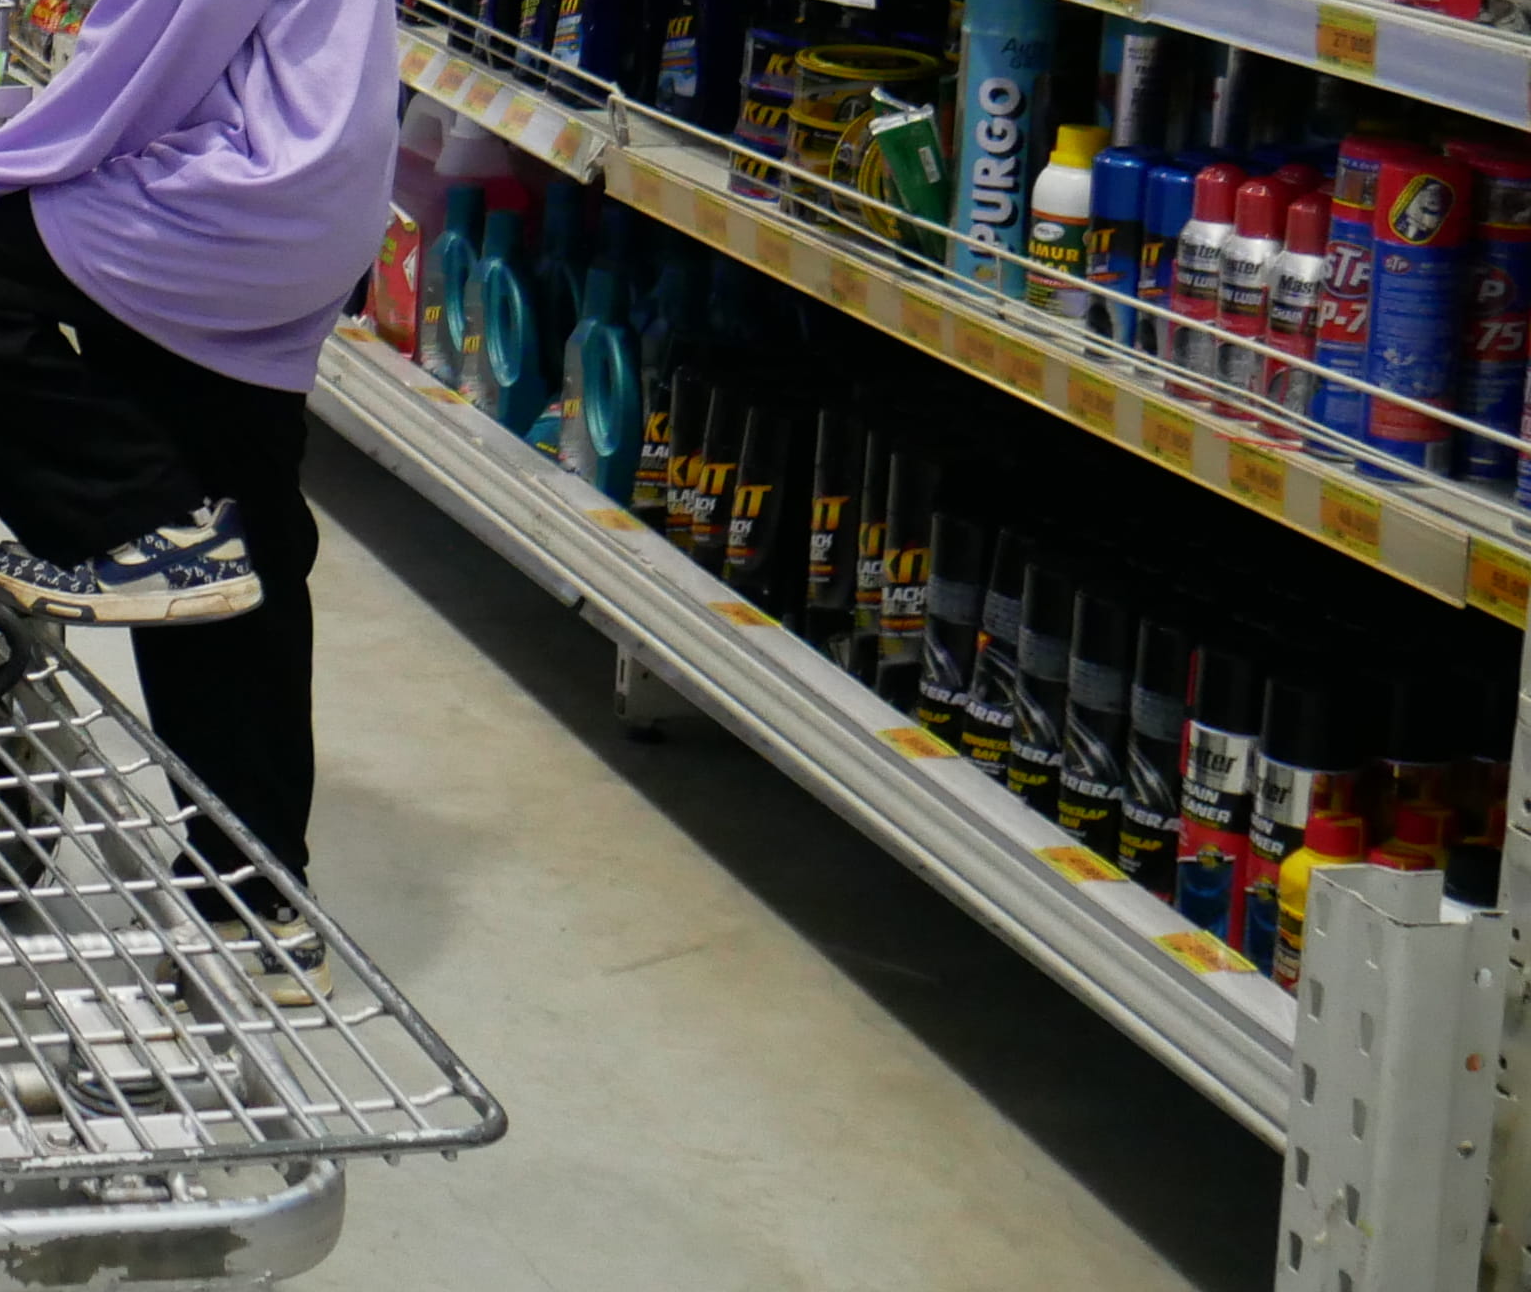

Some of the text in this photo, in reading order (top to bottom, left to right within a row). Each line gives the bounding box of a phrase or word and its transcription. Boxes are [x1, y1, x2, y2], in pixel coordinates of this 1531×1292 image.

[667, 15, 694, 38] KIT
[743, 100, 785, 129] KIT
[967, 77, 1022, 257] PURGO
[1317, 299, 1369, 334] P-7
[1477, 321, 1526, 351] 75
[699, 463, 737, 495] IT
[733, 485, 772, 518] IT
[811, 496, 850, 531] IT
[883, 586, 927, 604] LACK
